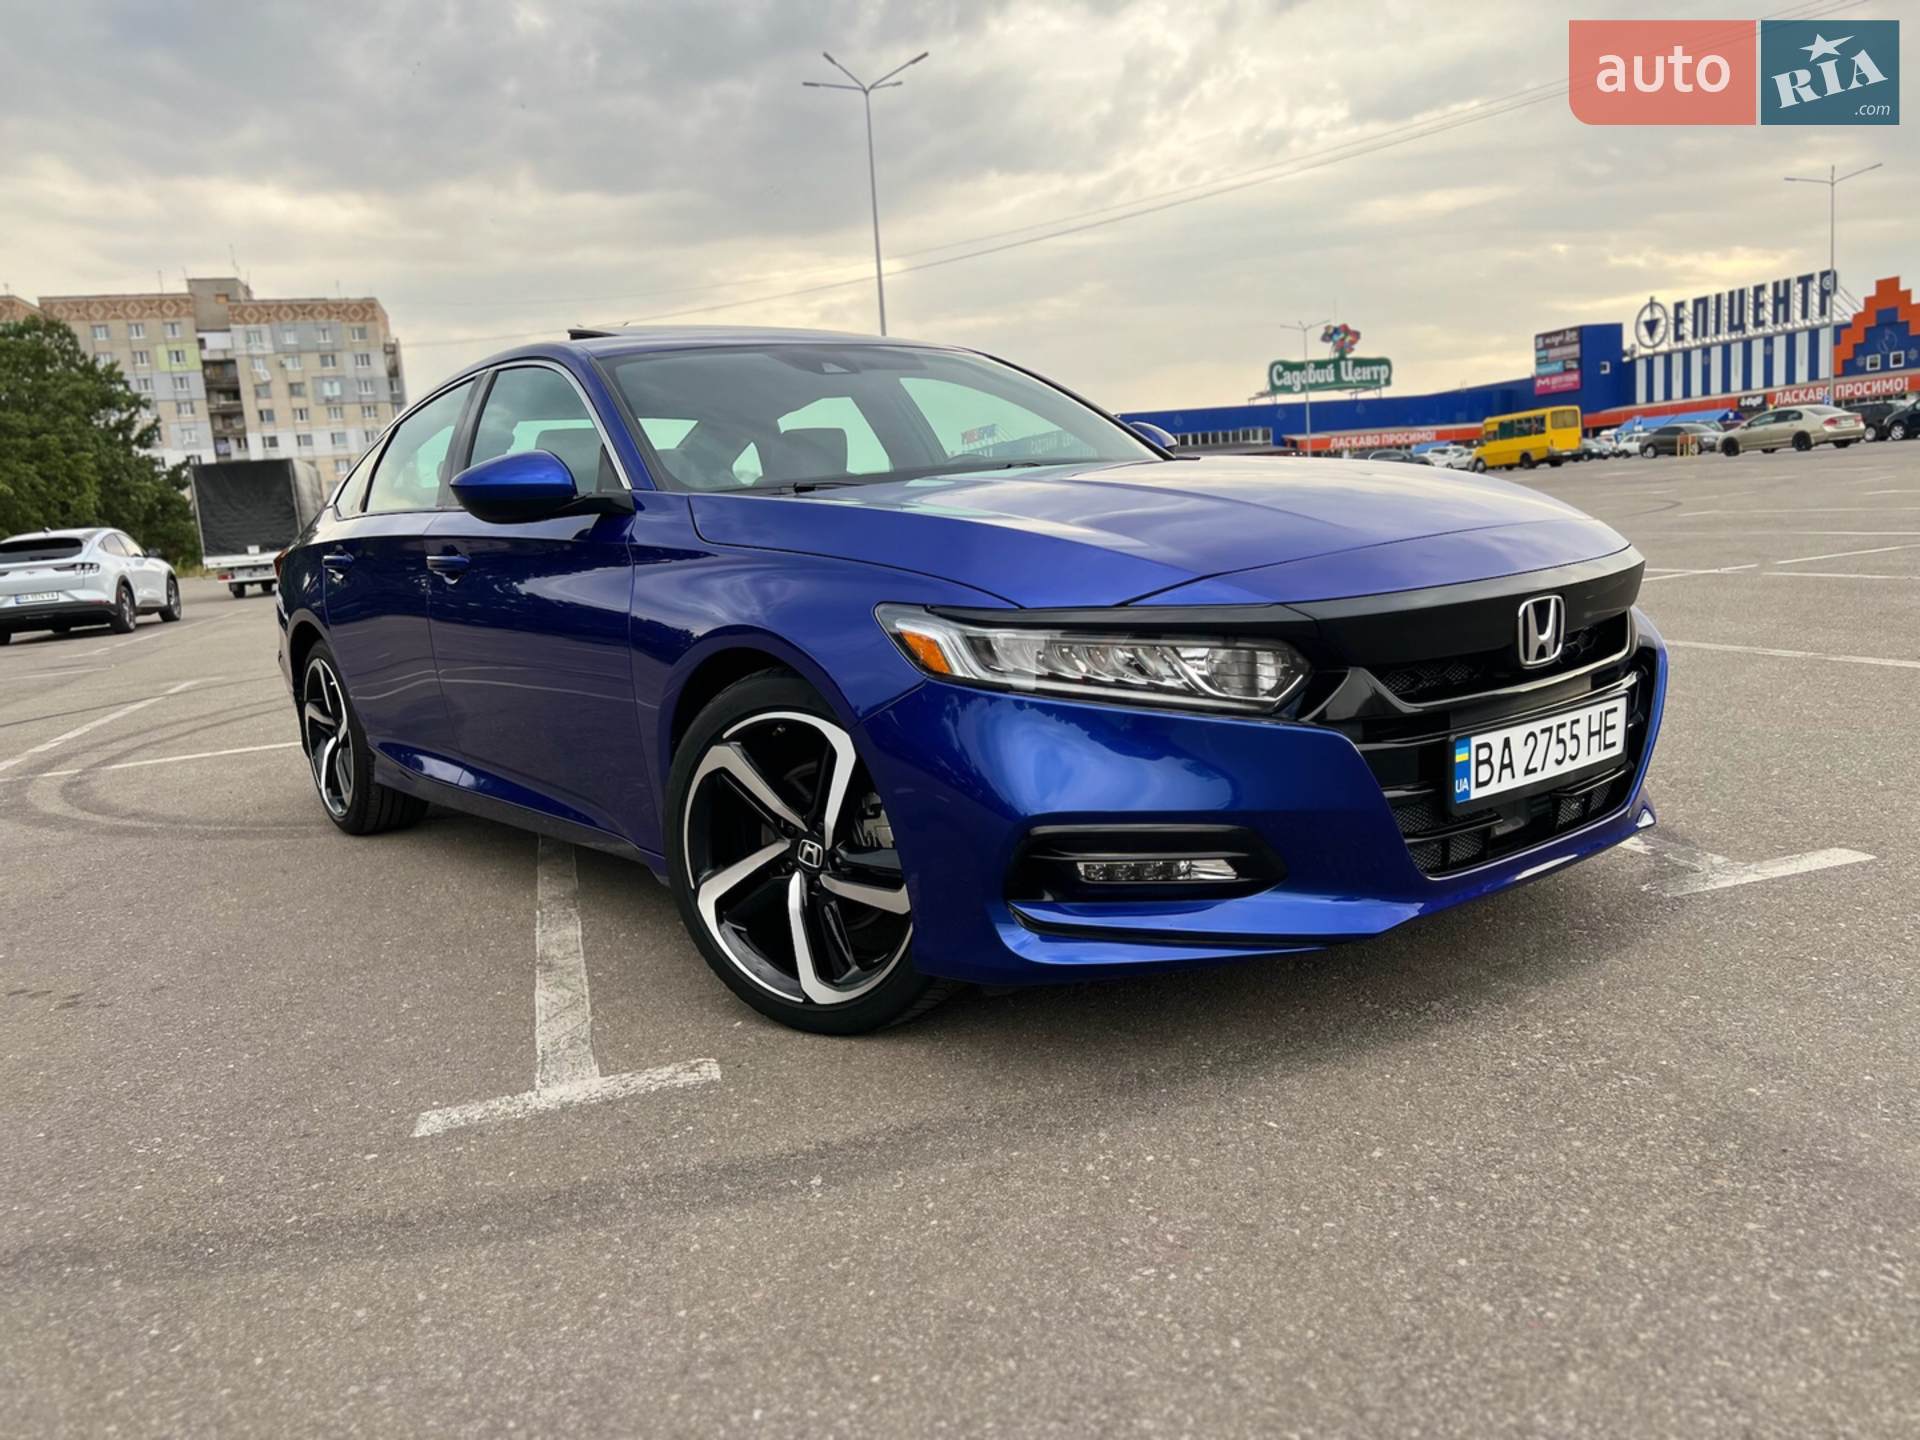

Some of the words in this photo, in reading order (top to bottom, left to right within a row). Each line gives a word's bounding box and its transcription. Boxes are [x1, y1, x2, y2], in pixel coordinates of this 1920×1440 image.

[1673, 269, 1837, 342] ЕПІЦЕНТР
[1272, 363, 1335, 392] Садовий
[1340, 360, 1390, 385] Центр
[1774, 388, 1830, 405] ЛАСКАВ
[1835, 376, 1909, 398] ПРОСИМО!
[1330, 435, 1380, 449] ЛАСКАВО
[1382, 432, 1436, 446] ПРОСИМО!
[1475, 736, 1516, 789] BA
[1523, 718, 1581, 777] 2755
[1587, 706, 1618, 757] HE
[1456, 777, 1469, 793] UA
